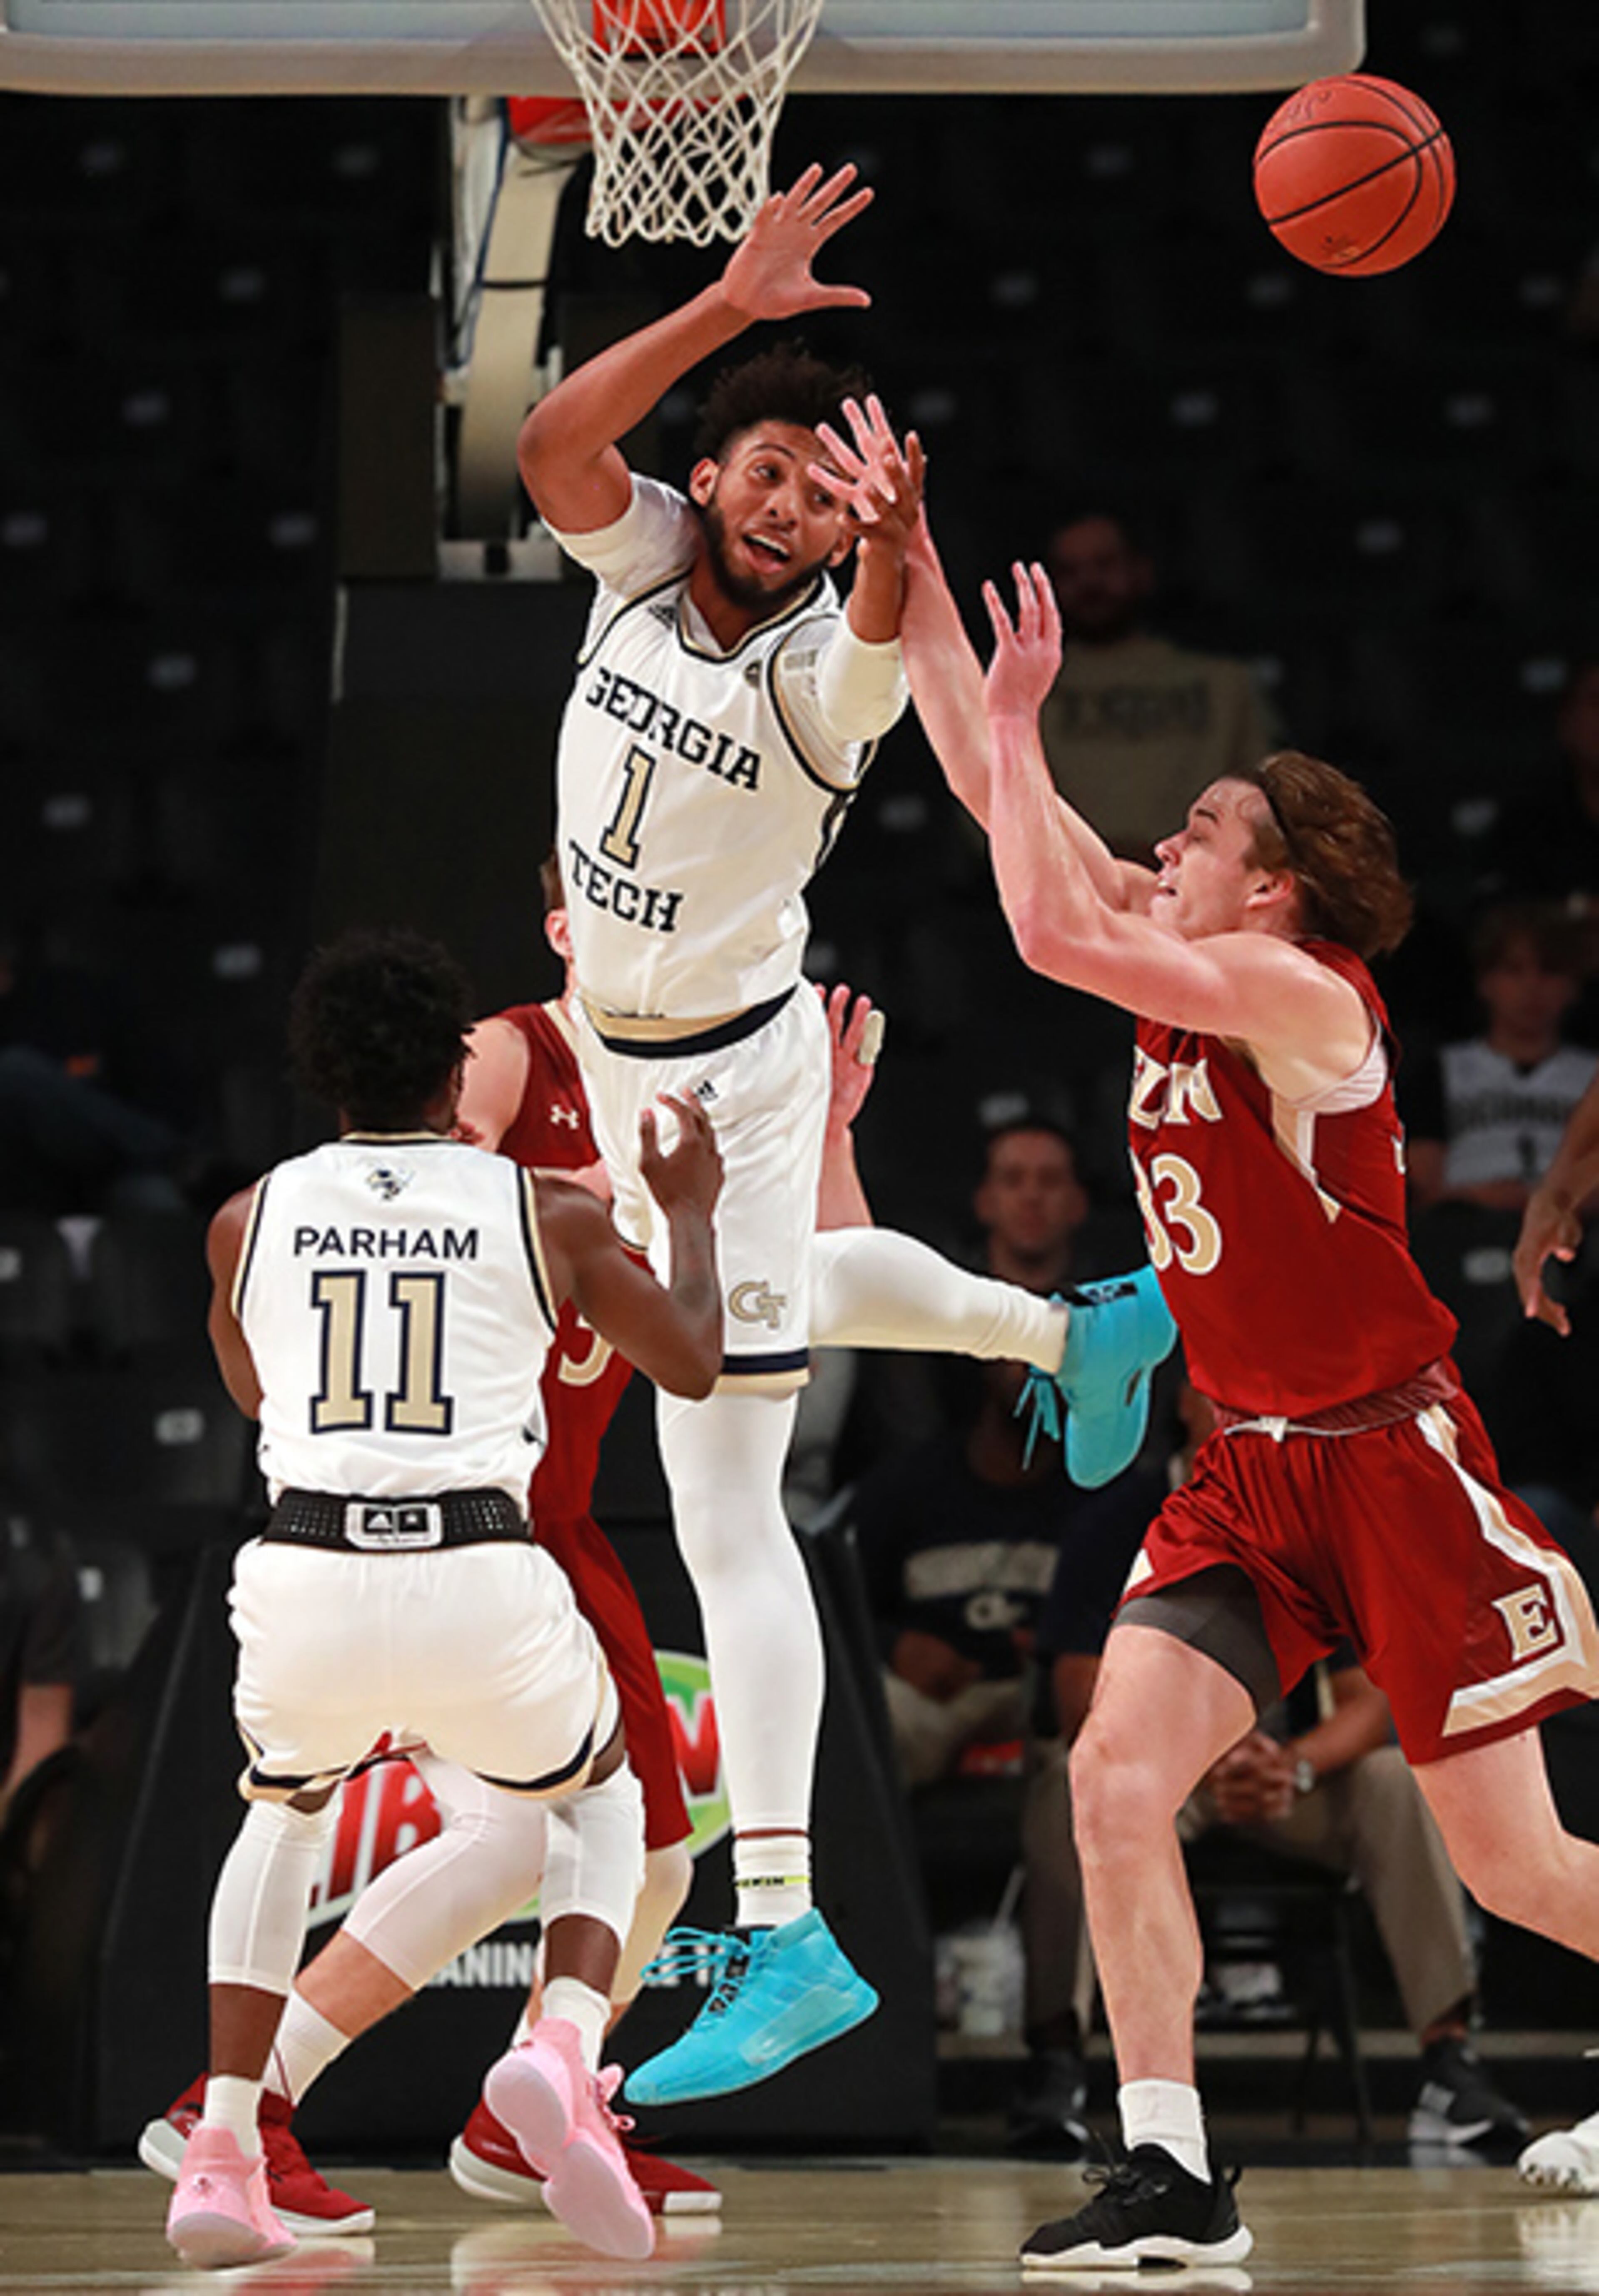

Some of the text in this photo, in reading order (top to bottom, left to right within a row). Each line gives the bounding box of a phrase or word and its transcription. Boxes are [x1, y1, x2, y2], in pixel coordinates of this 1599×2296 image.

[585, 666, 762, 790] GEORGIA
[599, 745, 656, 870] 1
[569, 839, 684, 932] TECH
[293, 1226, 479, 1260] PARHAM
[309, 1268, 454, 1436] 11
[1490, 1582, 1559, 1662] E
